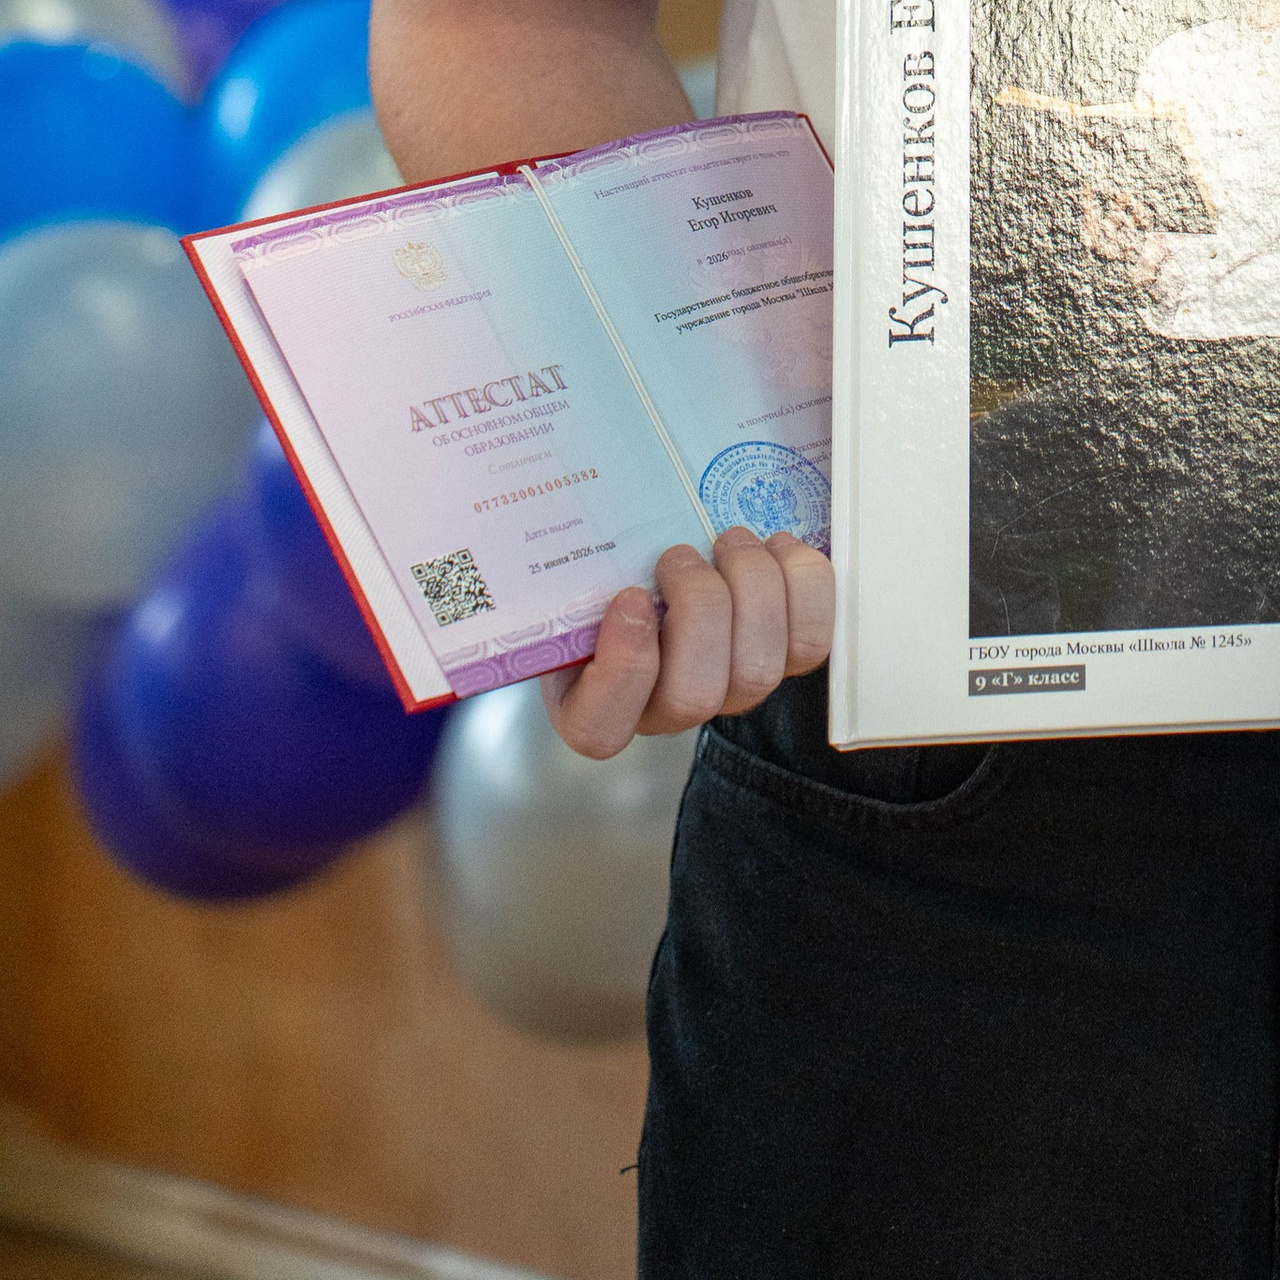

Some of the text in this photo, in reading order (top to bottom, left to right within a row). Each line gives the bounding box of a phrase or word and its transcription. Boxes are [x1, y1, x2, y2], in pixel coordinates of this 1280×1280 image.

[594, 176, 650, 200] Настоящий
[651, 167, 687, 184] аттестат
[689, 155, 752, 174] свидетельствует
[692, 189, 754, 211] Кушенков
[889, 51, 948, 349] Кушенков
[687, 203, 778, 233] Егор Игоревич
[706, 251, 729, 266] 2026
[727, 245, 746, 258] году
[389, 289, 493, 323] РОССИЙСКАЯ ФЕДЕРАЦИЯ
[654, 293, 731, 323] Государственное
[731, 280, 780, 300] бюджетное
[676, 310, 731, 335] учреждение
[732, 301, 761, 318] города
[761, 290, 797, 308] Москвы
[409, 364, 569, 433] АТТЕСТАТ
[746, 404, 795, 427] получил(а)
[432, 399, 570, 447] ОБ ОСНОВНОМ ОБЩЕМ
[464, 422, 555, 457] ОБРАЗОВАНИИ
[473, 468, 599, 514] 07732001005382
[525, 516, 584, 543] Дата выдачи
[529, 541, 617, 575] 25 июня 2026 года
[969, 634, 1252, 661] ГБОУ города Москвы «Школа № 1245»
[975, 670, 1080, 691] 9 «Г» класс
